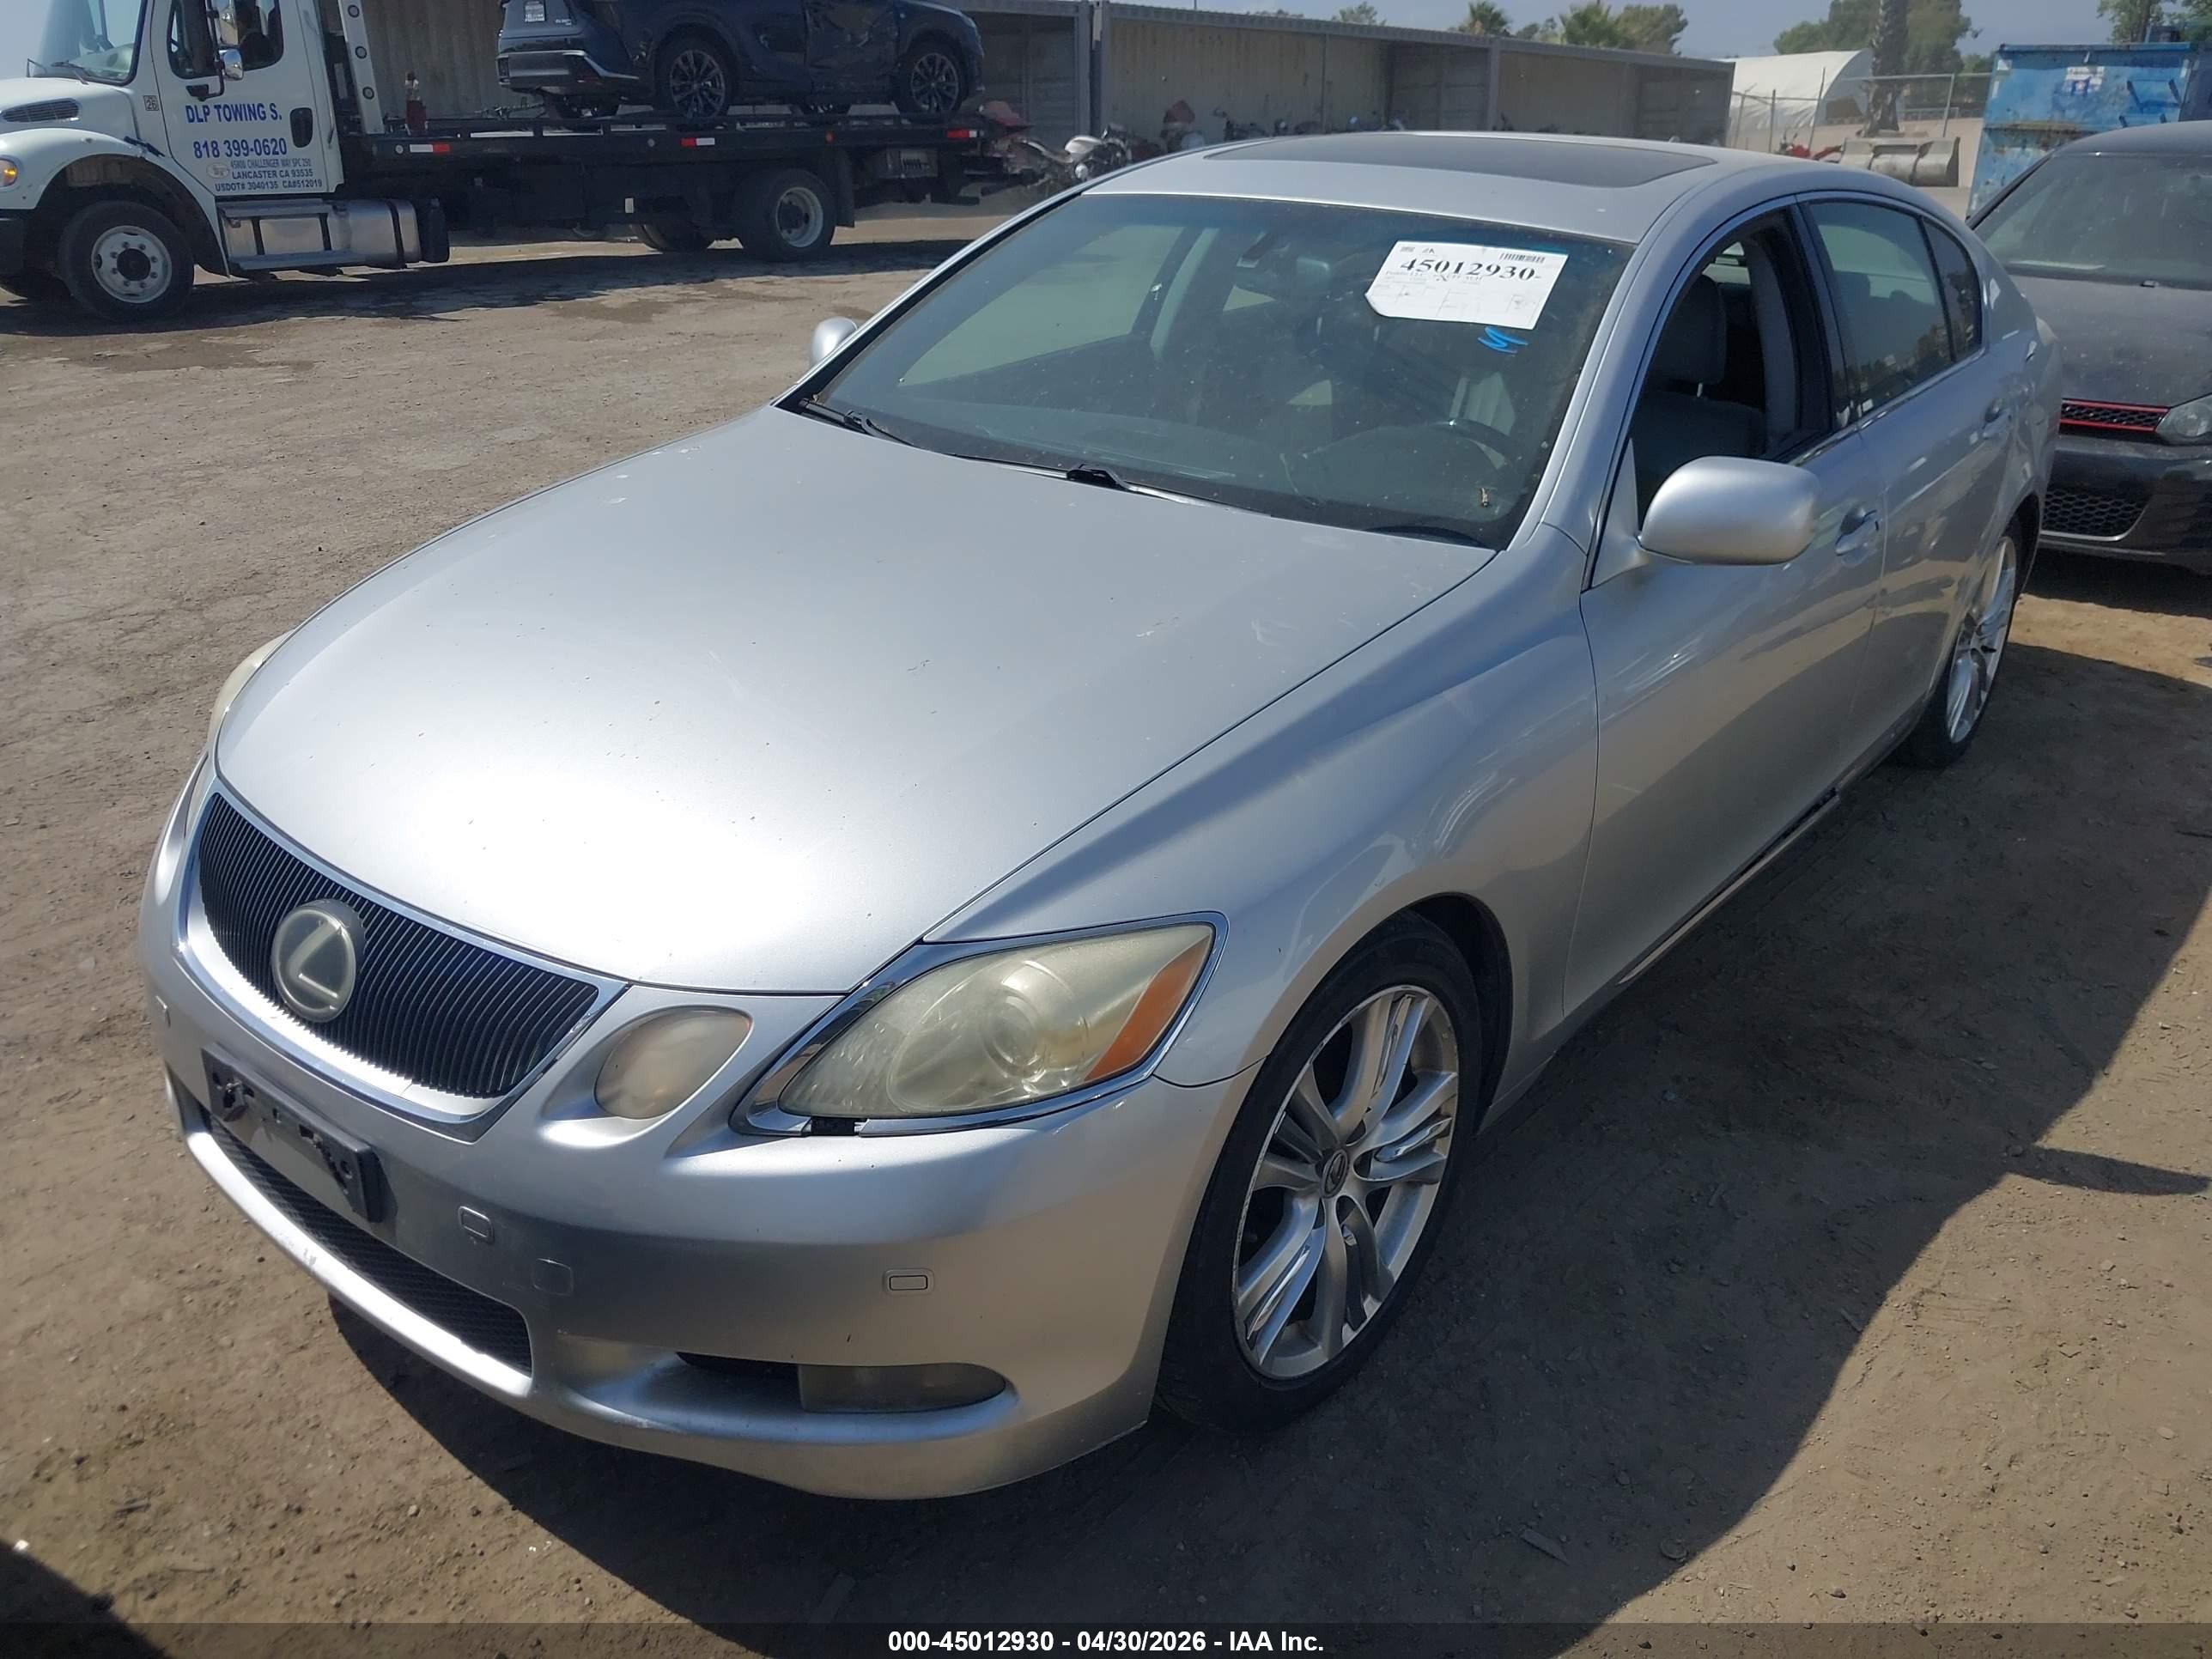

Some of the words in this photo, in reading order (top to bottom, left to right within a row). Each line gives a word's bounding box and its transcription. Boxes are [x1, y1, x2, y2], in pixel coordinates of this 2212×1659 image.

[185, 105, 210, 123] DLP
[215, 104, 266, 123] TOWING
[270, 103, 283, 121] S.
[193, 141, 220, 159] 818
[223, 137, 288, 158] 399-0620
[246, 159, 279, 168] CHALLENGER
[232, 170, 277, 179] LANCASTER
[279, 169, 290, 179] CA
[290, 168, 313, 178] 93535
[215, 182, 246, 192] USDOT#
[247, 181, 279, 191] 3040135
